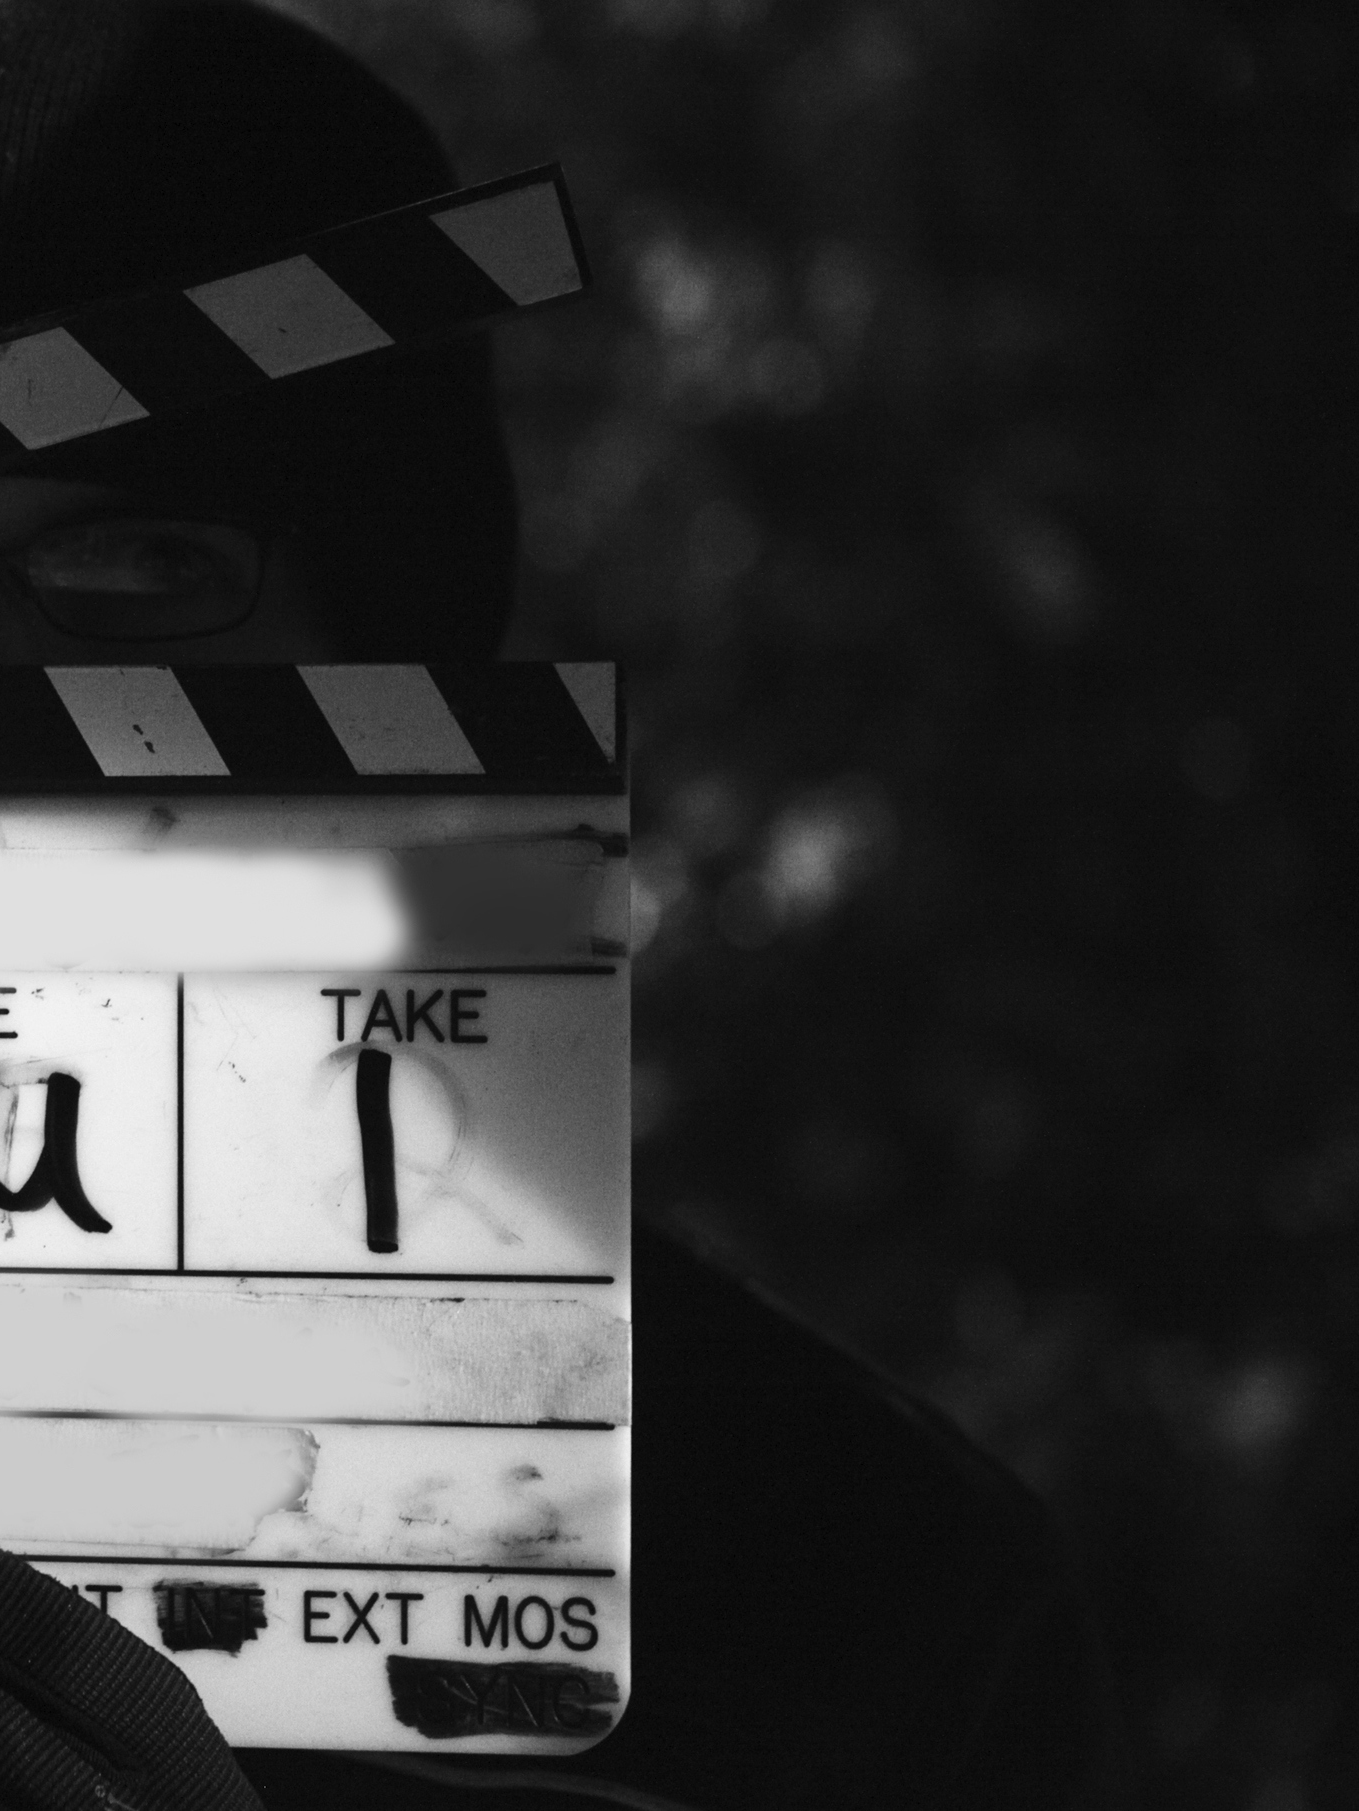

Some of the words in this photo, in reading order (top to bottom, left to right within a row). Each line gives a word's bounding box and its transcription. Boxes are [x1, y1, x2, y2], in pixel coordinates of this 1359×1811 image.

[321, 988, 488, 1043] TAKE
[355, 1048, 400, 1254] 1
[303, 1590, 424, 1645] EXT
[463, 1594, 599, 1651] MOS
